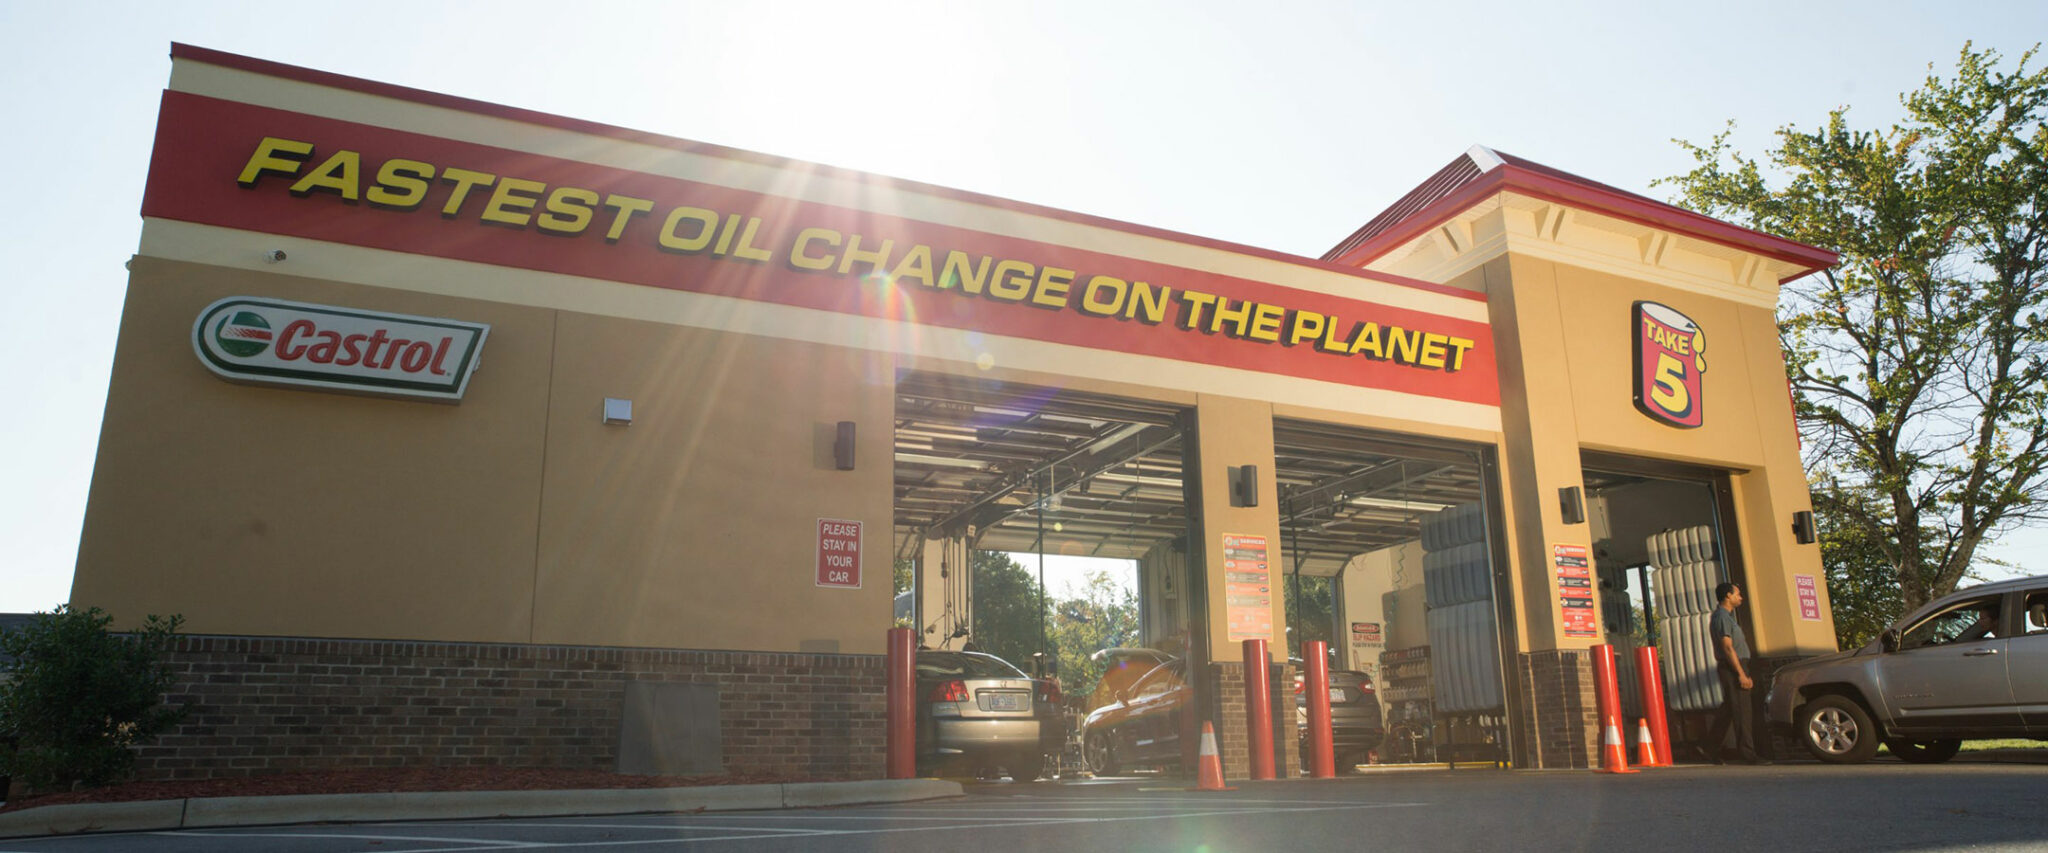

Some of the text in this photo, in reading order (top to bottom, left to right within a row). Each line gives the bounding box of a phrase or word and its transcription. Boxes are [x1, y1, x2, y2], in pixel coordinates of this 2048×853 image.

[237, 136, 1475, 373] FASTEST OIL CHANGE ON THE PLANET
[275, 319, 453, 376] Castrol
[1644, 317, 1689, 355] TAKE
[1650, 352, 1690, 416] 5
[823, 523, 857, 536] PLEASE
[823, 539, 857, 552] STAY IN
[826, 555, 853, 567] YOUR
[828, 570, 849, 583] CAR
